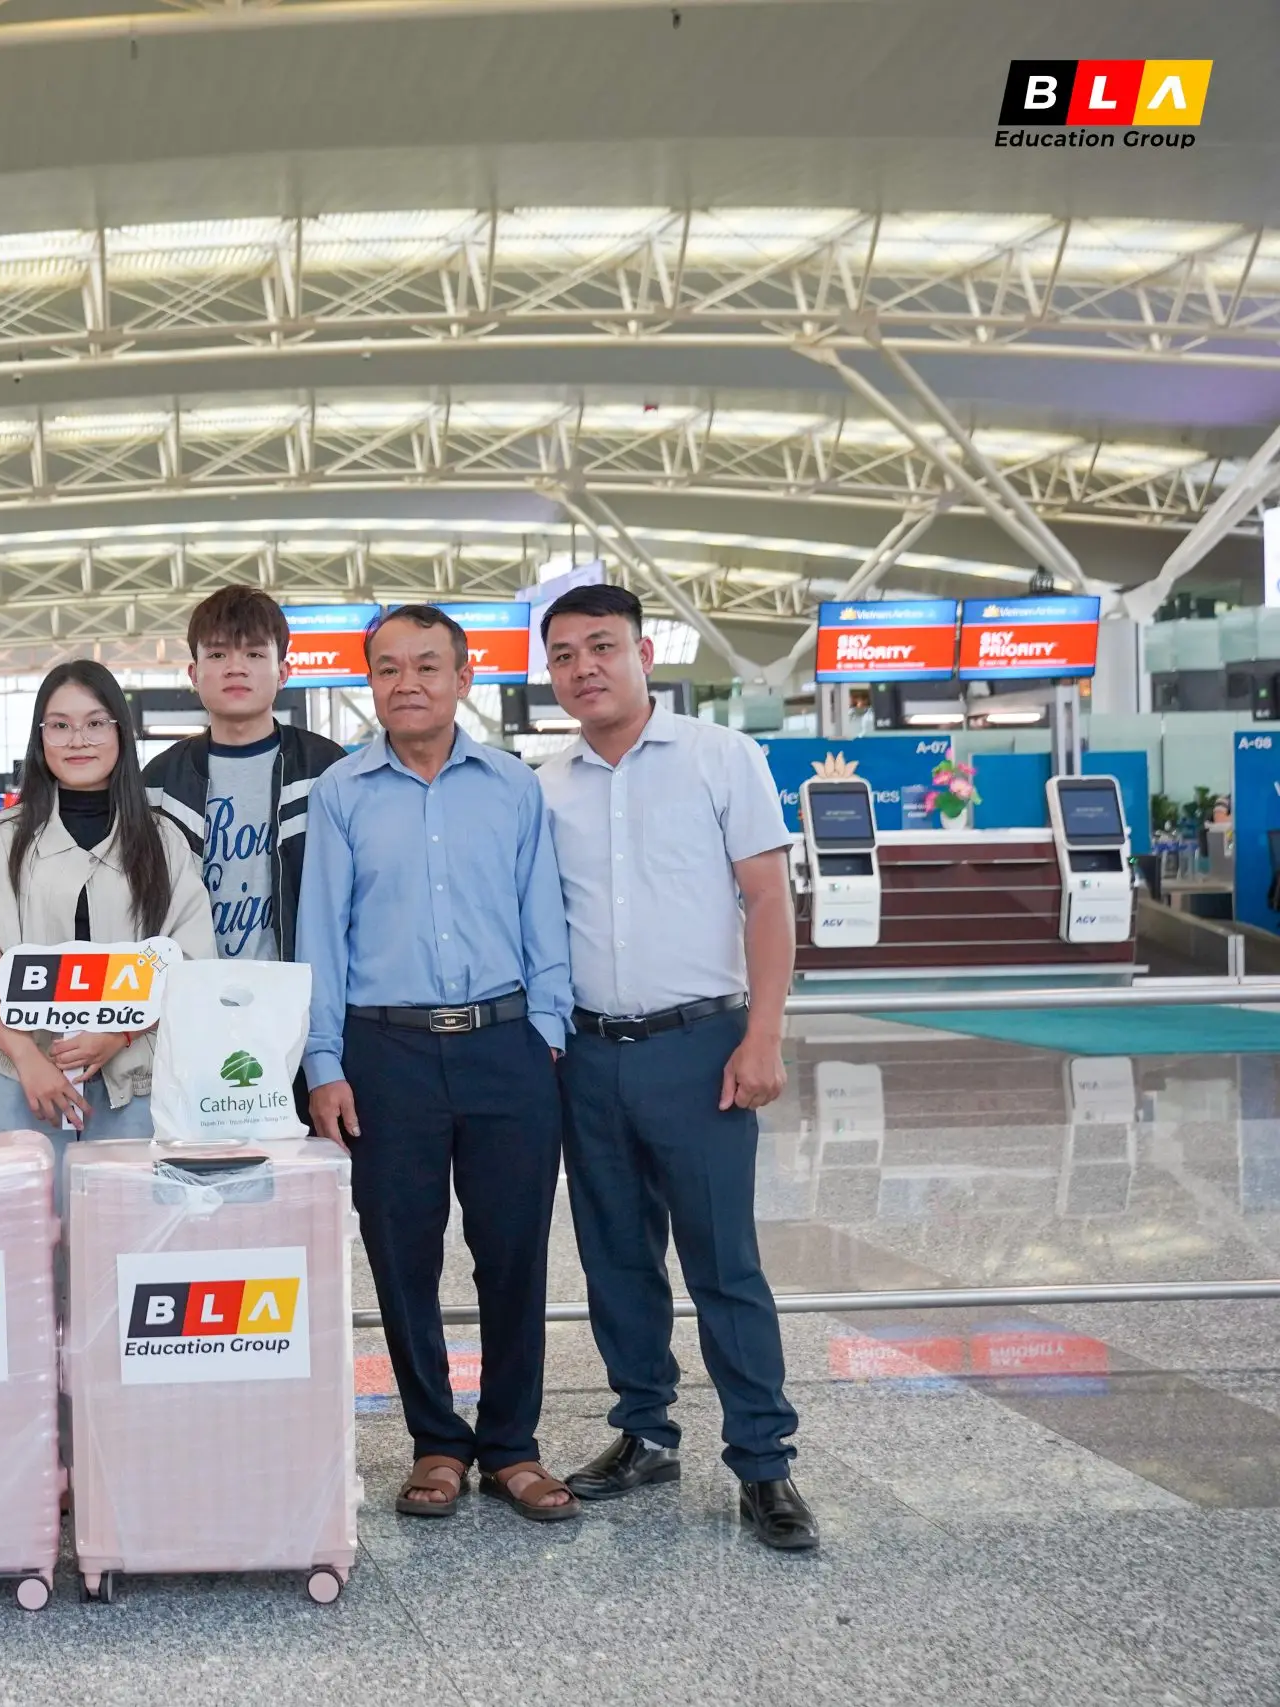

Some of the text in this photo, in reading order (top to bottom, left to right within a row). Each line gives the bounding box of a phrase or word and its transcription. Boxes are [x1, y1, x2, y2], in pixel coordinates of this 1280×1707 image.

[836, 645, 914, 660] PRIORITY
[979, 642, 1056, 657] PRIORITY
[5, 1005, 145, 1029] Du học Đức
[200, 1091, 288, 1114] Cathay Life
[124, 1337, 290, 1356] Education Group
